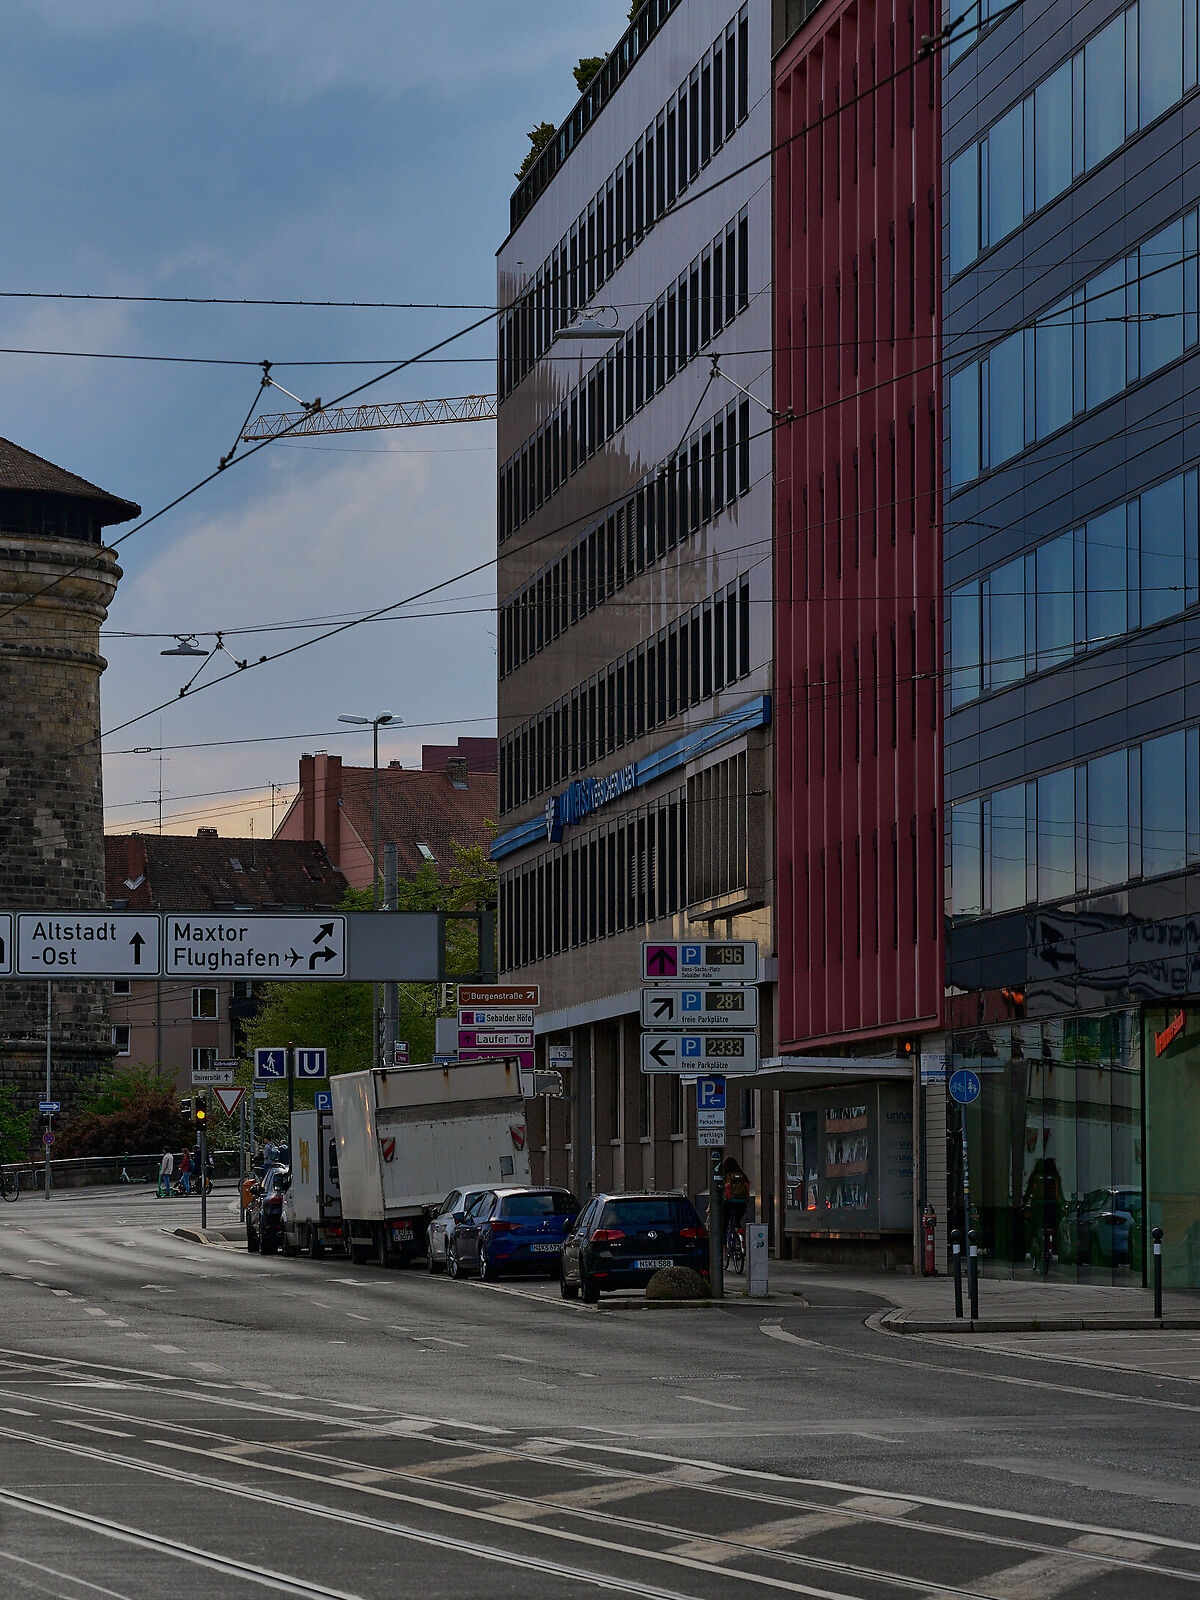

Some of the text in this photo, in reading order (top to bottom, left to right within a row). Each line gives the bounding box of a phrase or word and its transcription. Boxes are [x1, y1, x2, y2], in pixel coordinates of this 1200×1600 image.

[31, 922, 117, 942] Altstadt
[173, 923, 248, 942] Maxtor
[31, 947, 77, 966] -Ost
[173, 947, 280, 970] Flughafen
[686, 947, 743, 963] P 196
[471, 992, 524, 1001] Burgenstraße
[686, 994, 743, 1009] P 281
[486, 1014, 532, 1022] Sebalder Höfe
[698, 1016, 729, 1025] Parkplätze
[477, 1034, 530, 1044] Laufer Tor
[686, 1040, 743, 1056] P 2333
[303, 1053, 320, 1074] U
[698, 1062, 729, 1071] Parkplätze
[701, 1081, 716, 1105] P
